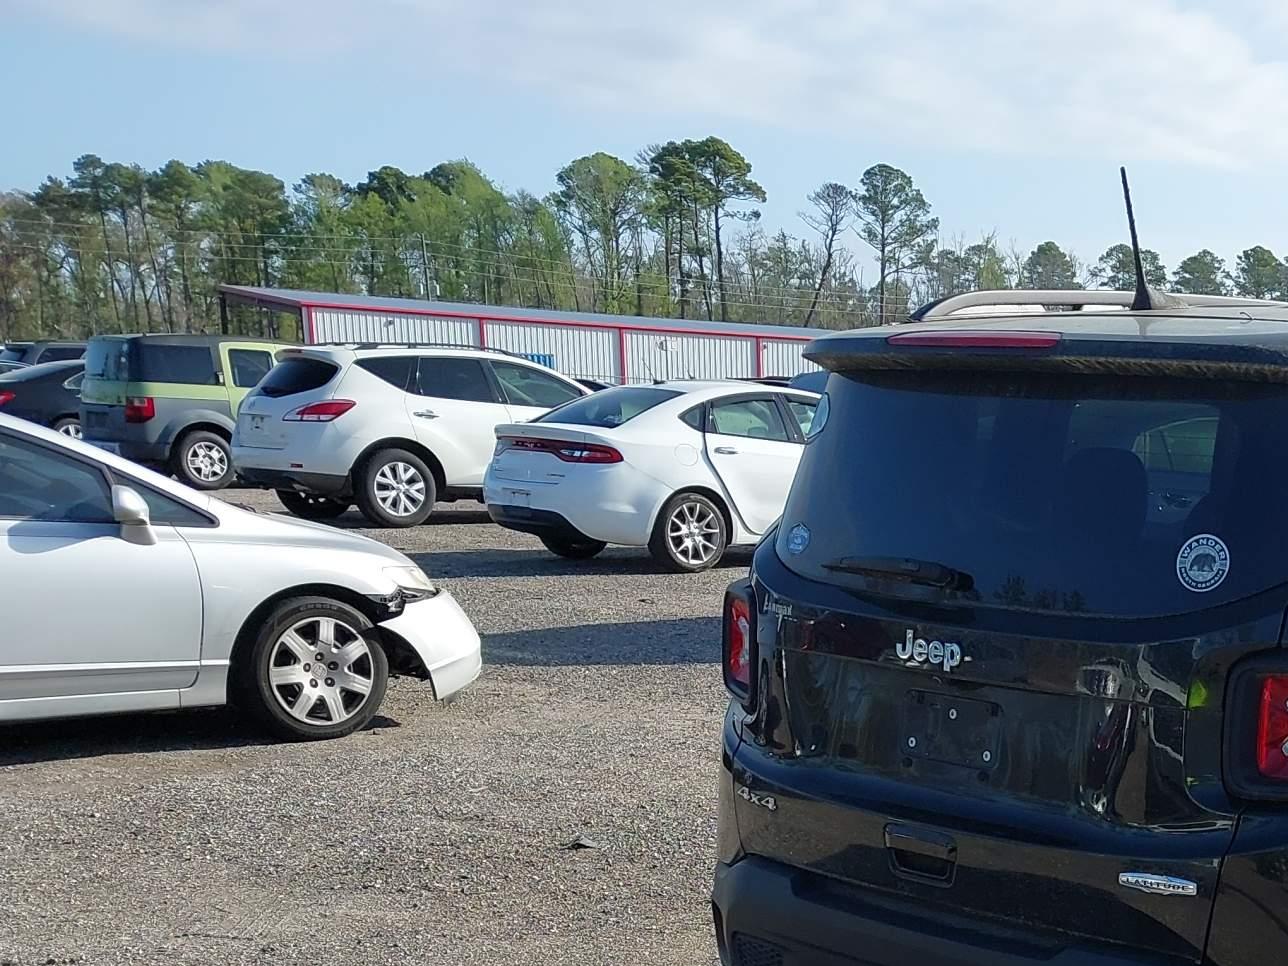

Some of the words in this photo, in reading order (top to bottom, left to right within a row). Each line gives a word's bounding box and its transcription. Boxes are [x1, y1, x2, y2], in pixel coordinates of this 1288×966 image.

[1181, 538, 1226, 560] WANDER
[896, 629, 961, 672] Jeep
[1125, 877, 1190, 892] LATITUDE
